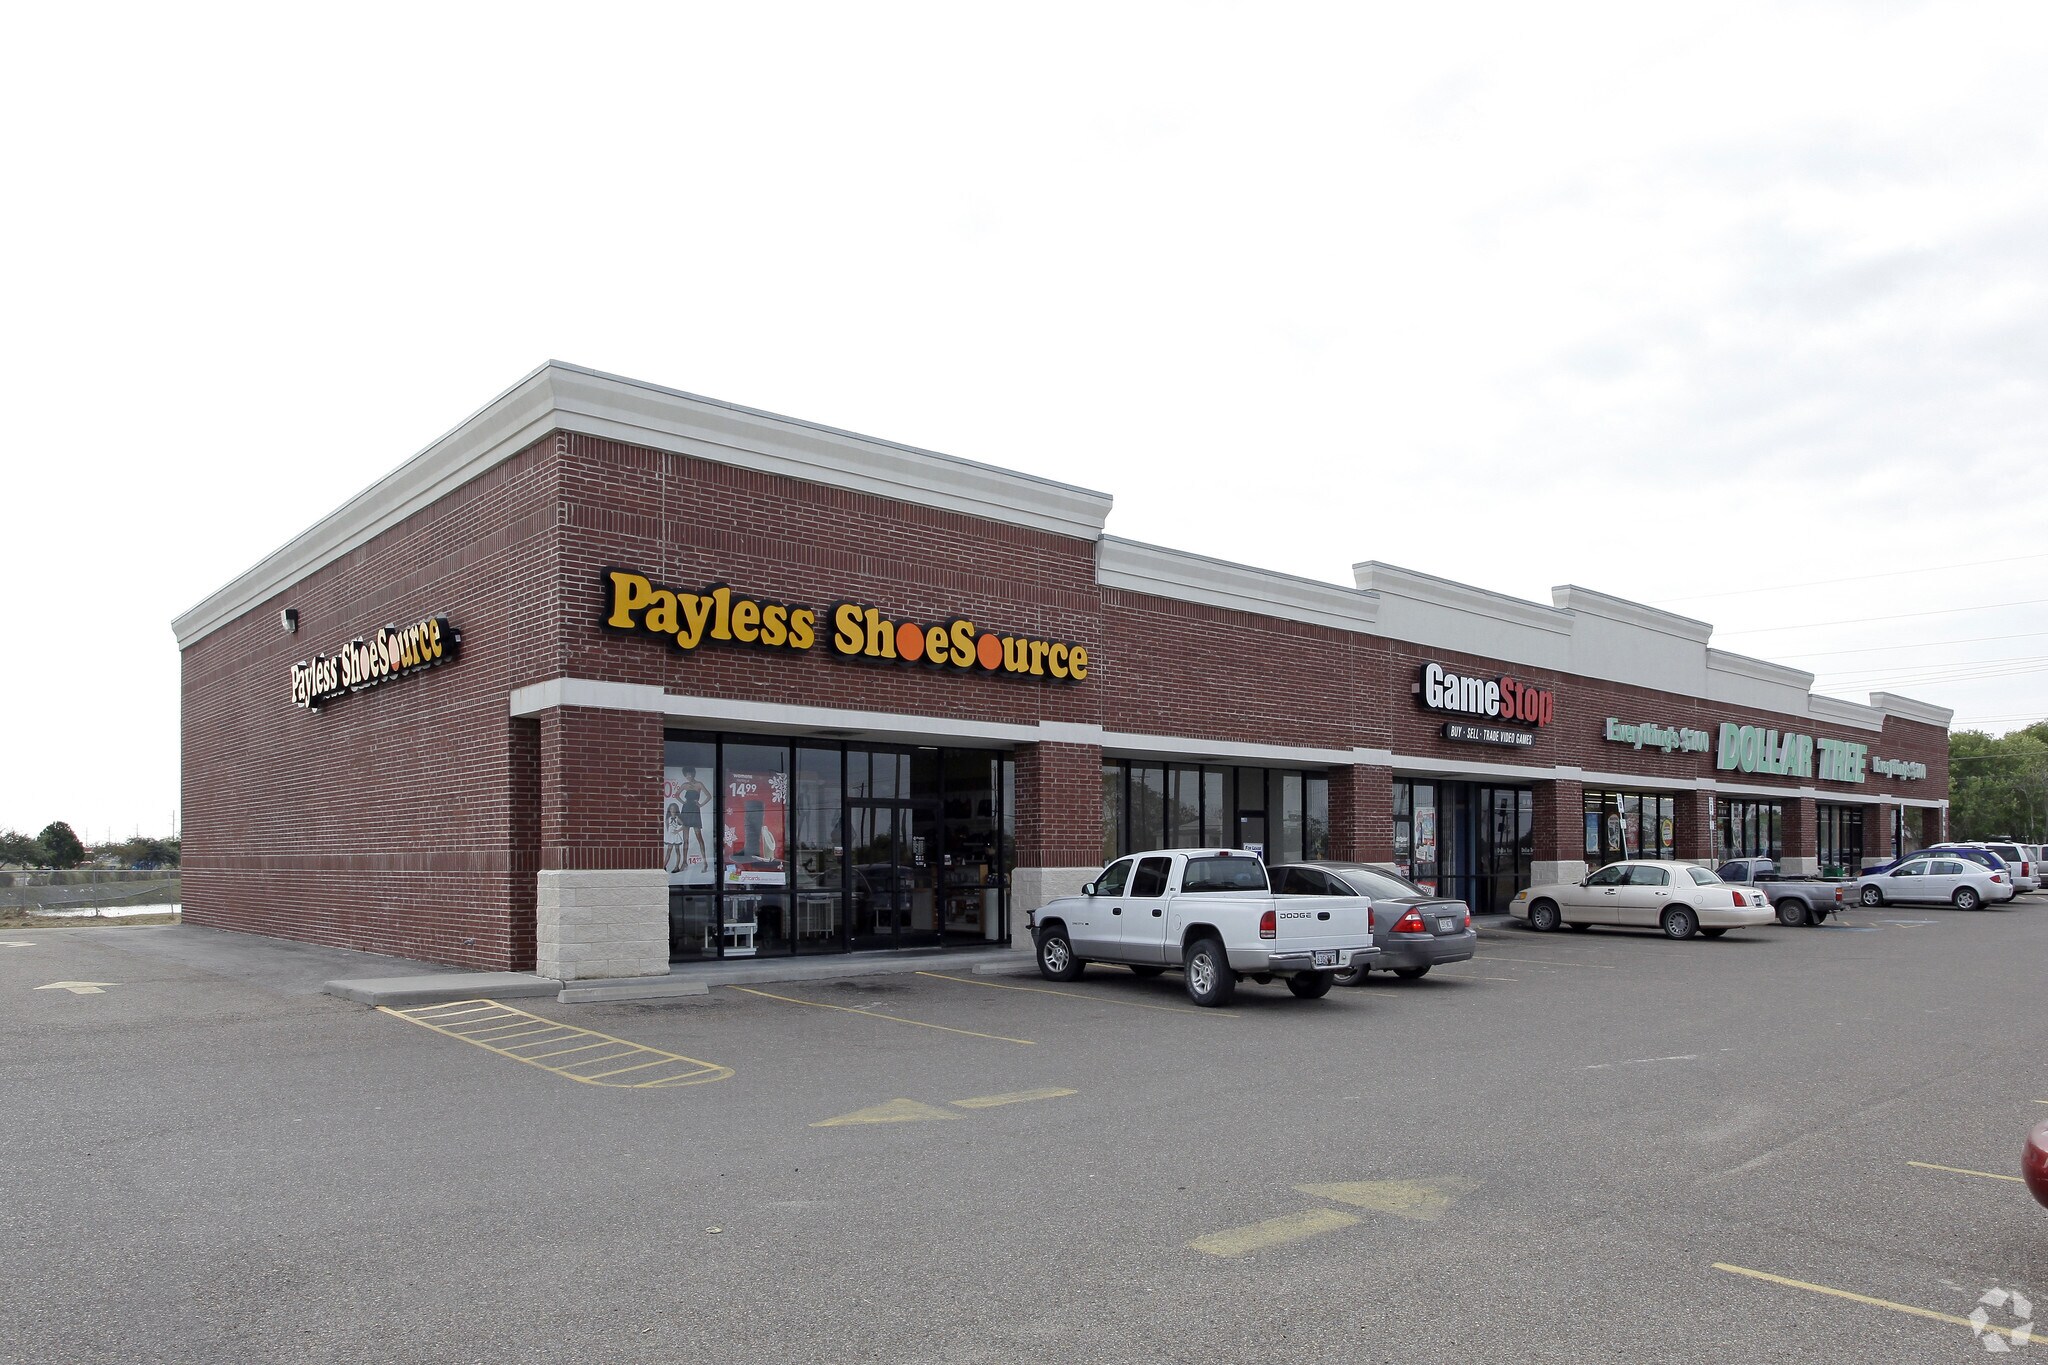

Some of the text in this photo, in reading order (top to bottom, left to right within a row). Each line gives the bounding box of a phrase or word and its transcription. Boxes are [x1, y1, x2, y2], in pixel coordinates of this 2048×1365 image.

[608, 571, 1088, 681] Payless ShoeSource
[291, 618, 442, 708] Payless ShoeSource
[1425, 663, 1553, 727] GameStop
[1450, 725, 1532, 745] BUY SELL TRADE VIDEO GAMES
[1718, 722, 1868, 783] DOLLAR TREE
[664, 781, 680, 798] 0%
